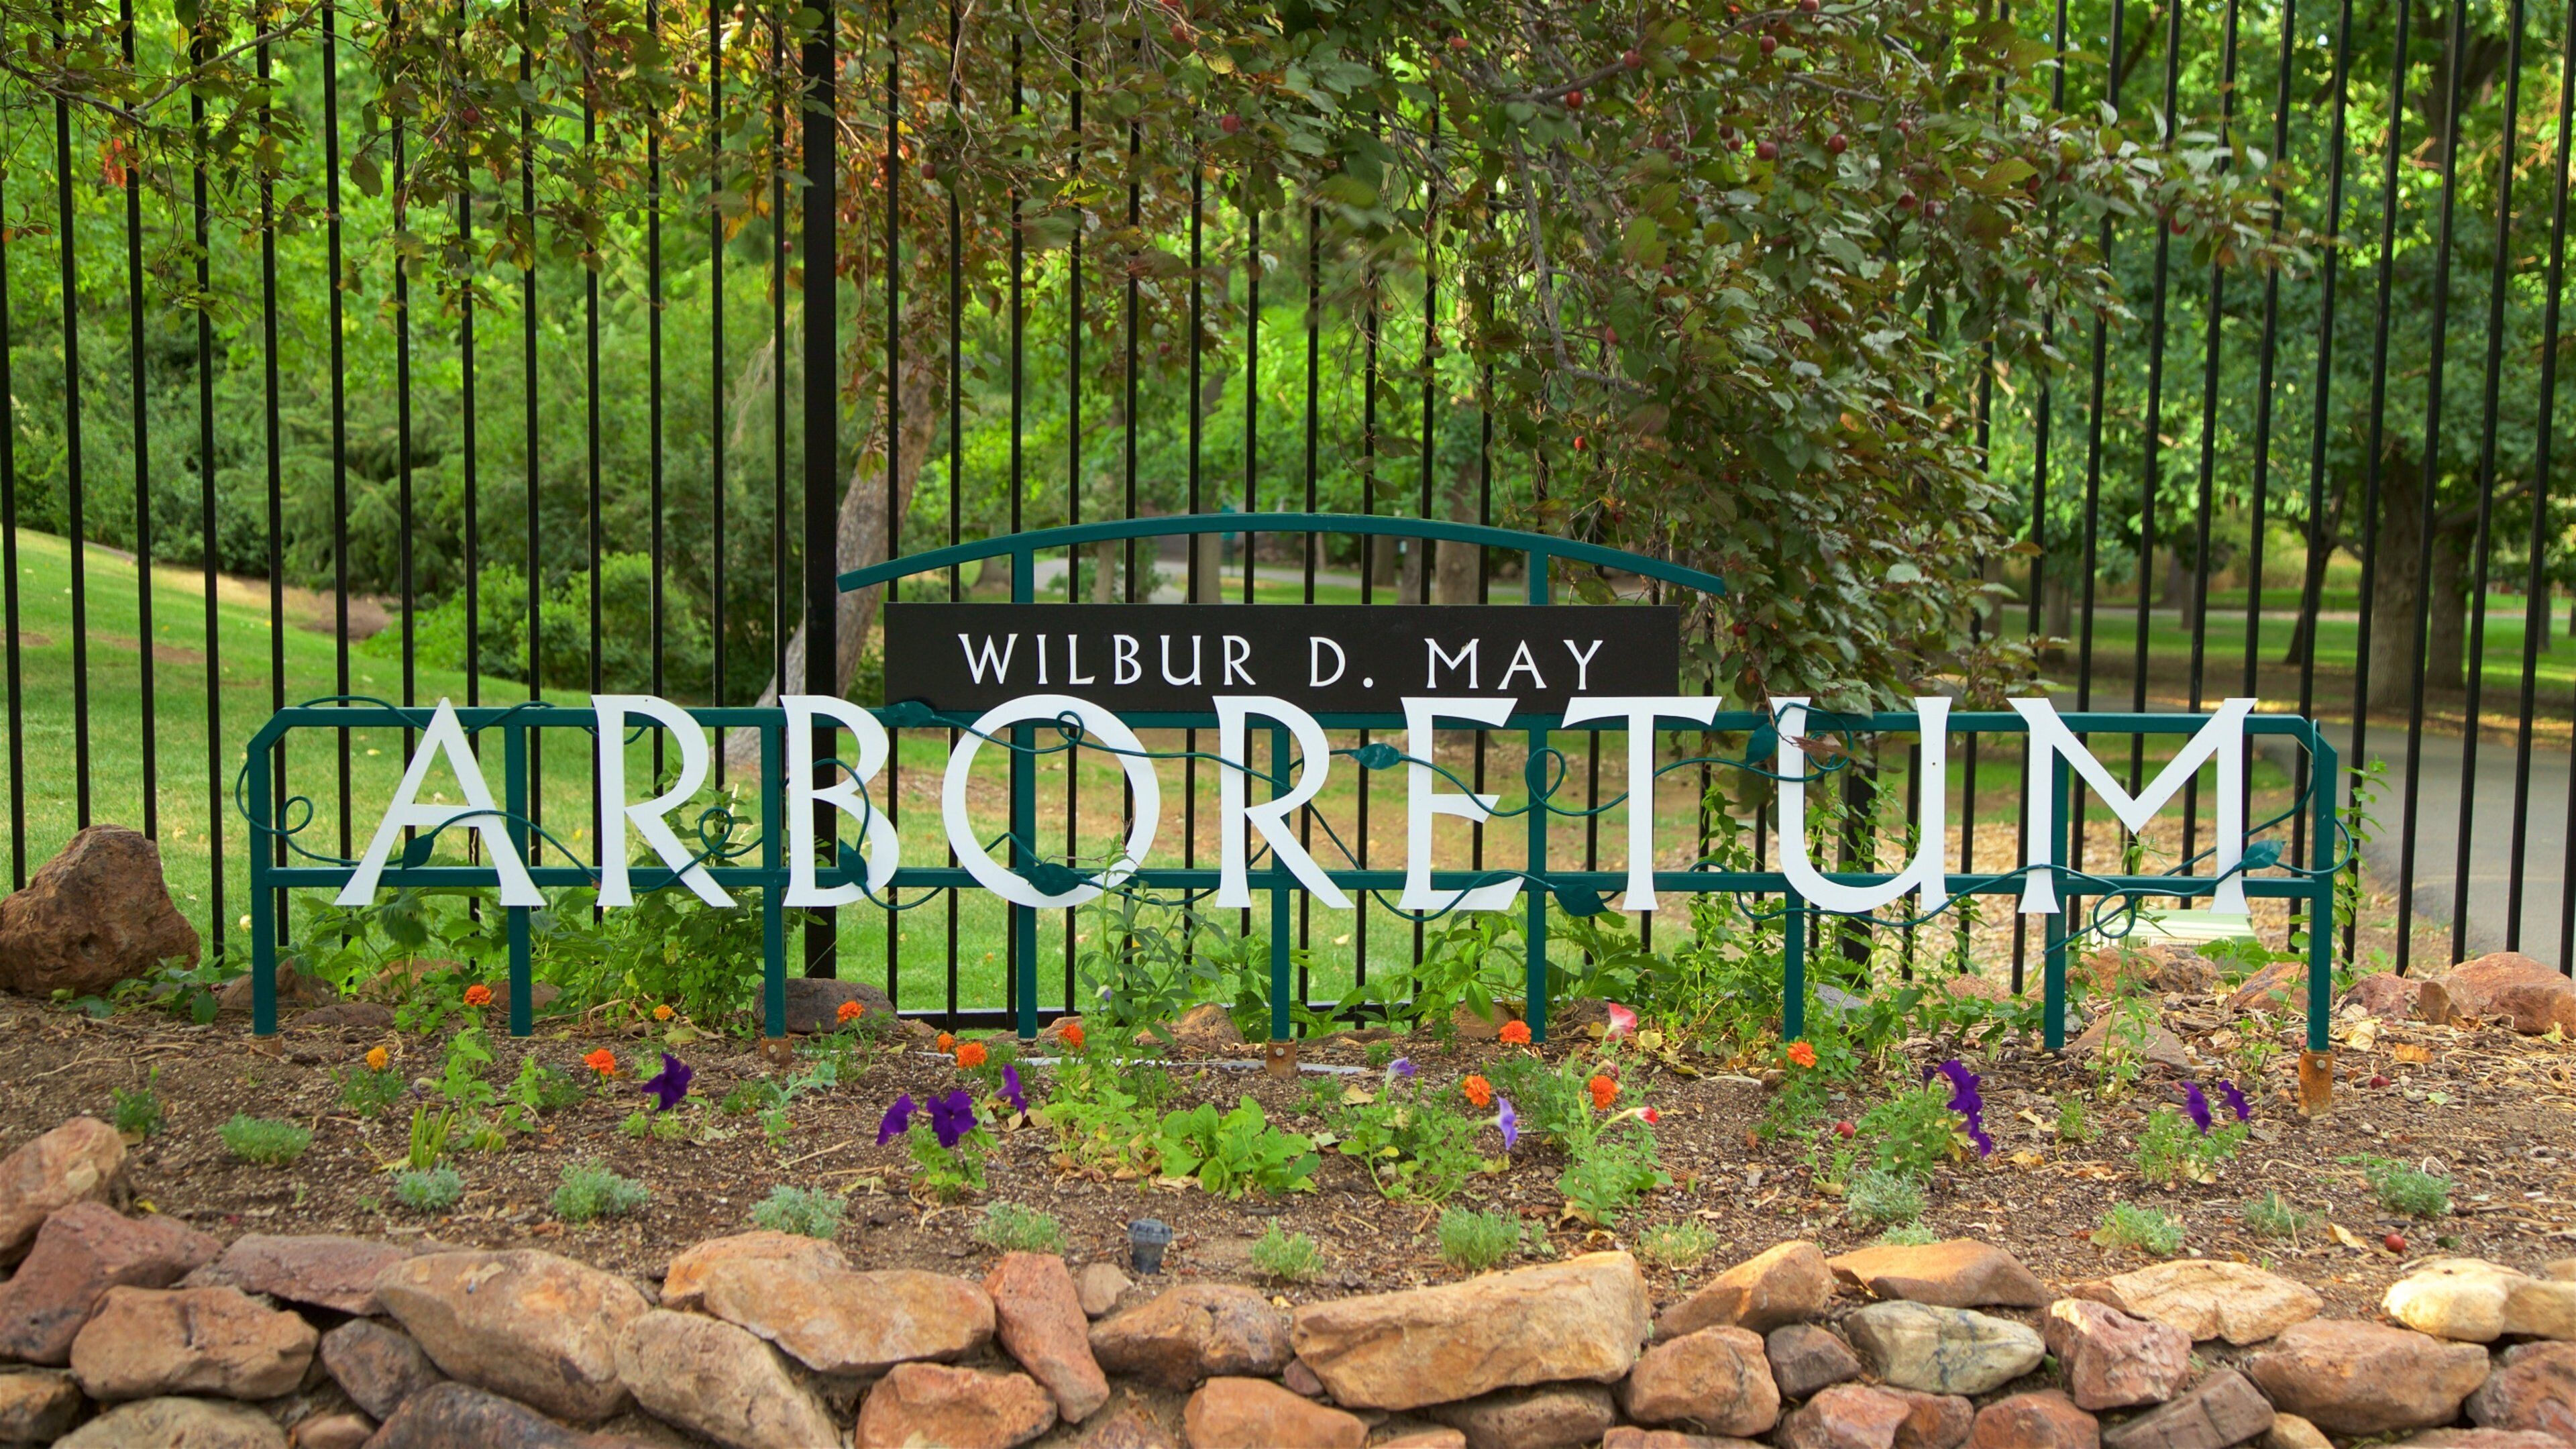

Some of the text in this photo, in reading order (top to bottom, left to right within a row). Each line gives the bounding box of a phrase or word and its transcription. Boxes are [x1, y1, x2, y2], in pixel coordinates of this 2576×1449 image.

[957, 633, 1603, 690] WILBUR D. MAY
[334, 694, 2259, 916] ARBORETUM
